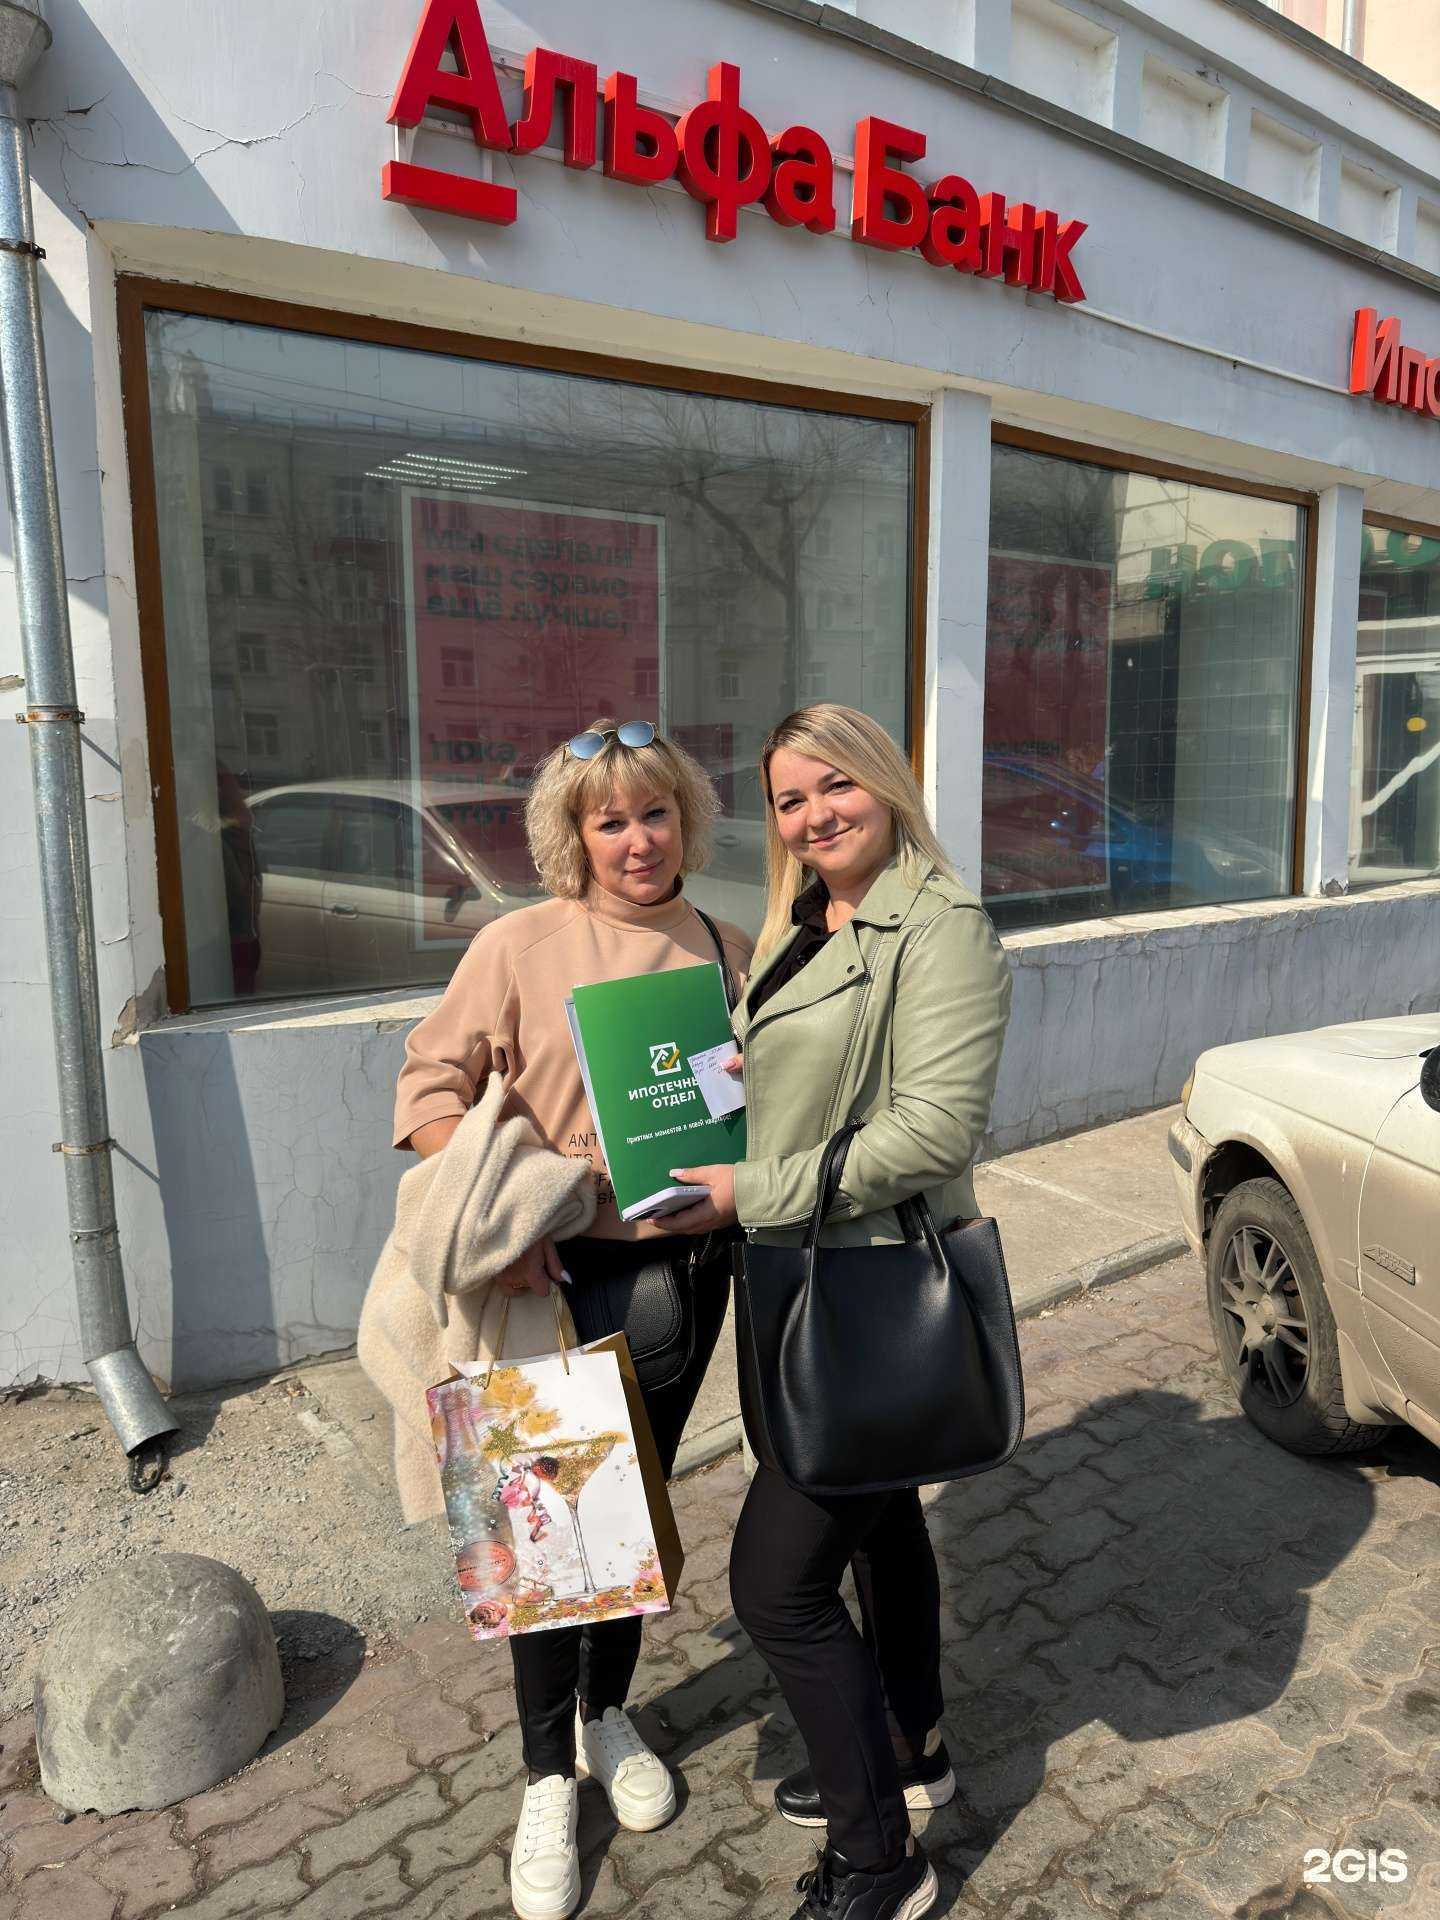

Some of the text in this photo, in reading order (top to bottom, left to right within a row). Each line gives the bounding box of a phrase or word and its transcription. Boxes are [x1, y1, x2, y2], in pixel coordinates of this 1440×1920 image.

[386, 0, 1088, 302] Альфа Банк
[425, 527, 485, 552] Мы
[425, 564, 500, 586] наш
[628, 1076, 699, 1101] ИПОТЕЧНЫ
[652, 1089, 696, 1109] ОТДЕЛ
[654, 1124, 682, 1138] моментов
[688, 1119, 704, 1130] новой
